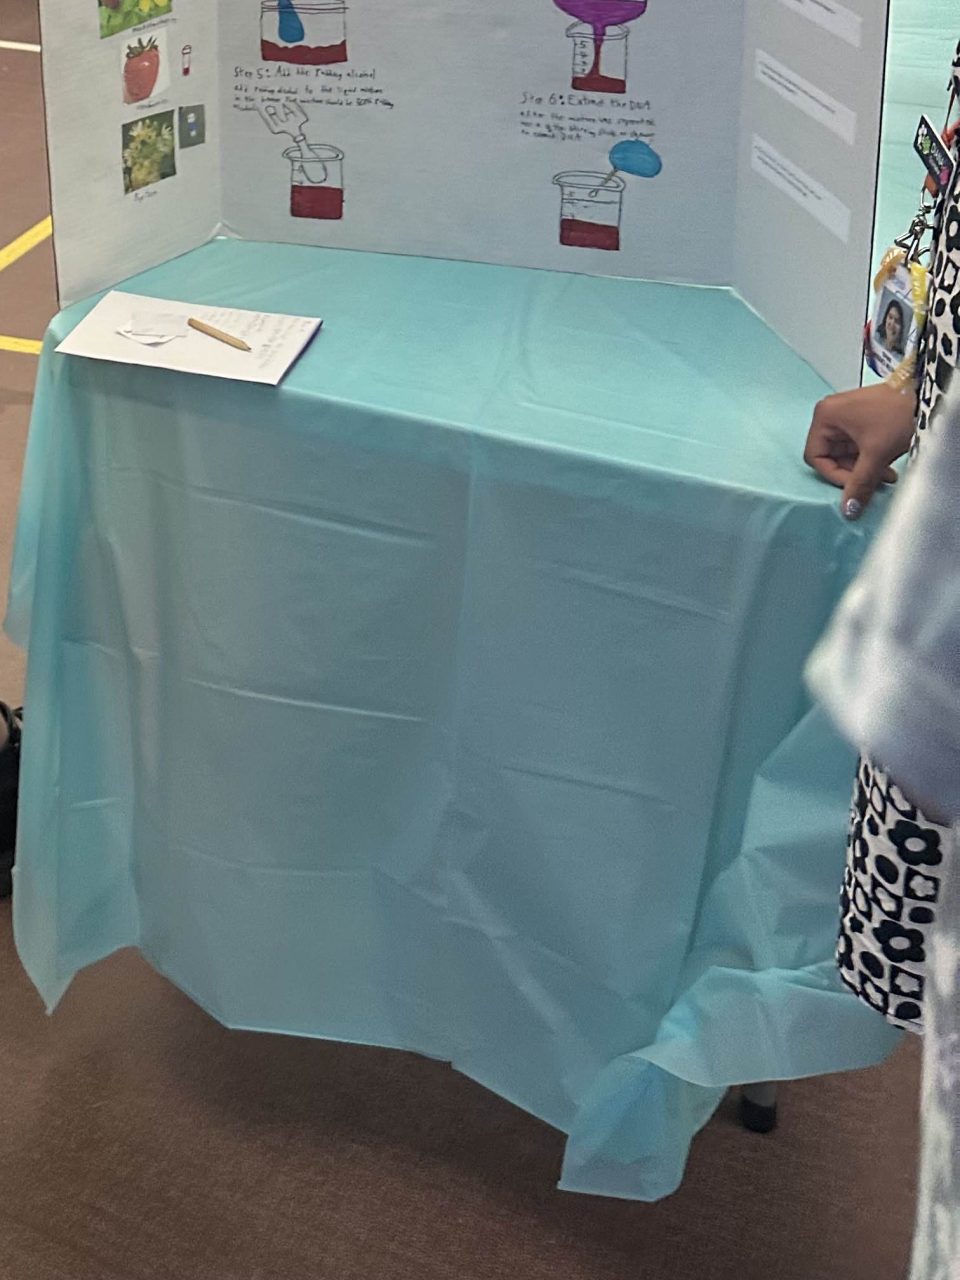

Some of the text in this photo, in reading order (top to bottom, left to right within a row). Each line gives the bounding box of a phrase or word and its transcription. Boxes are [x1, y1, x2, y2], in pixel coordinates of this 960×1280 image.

[234, 66, 252, 78] Step
[256, 68, 271, 79] 5:
[275, 65, 291, 77] Add
[520, 92, 542, 105] Step
[549, 92, 565, 106] 6:
